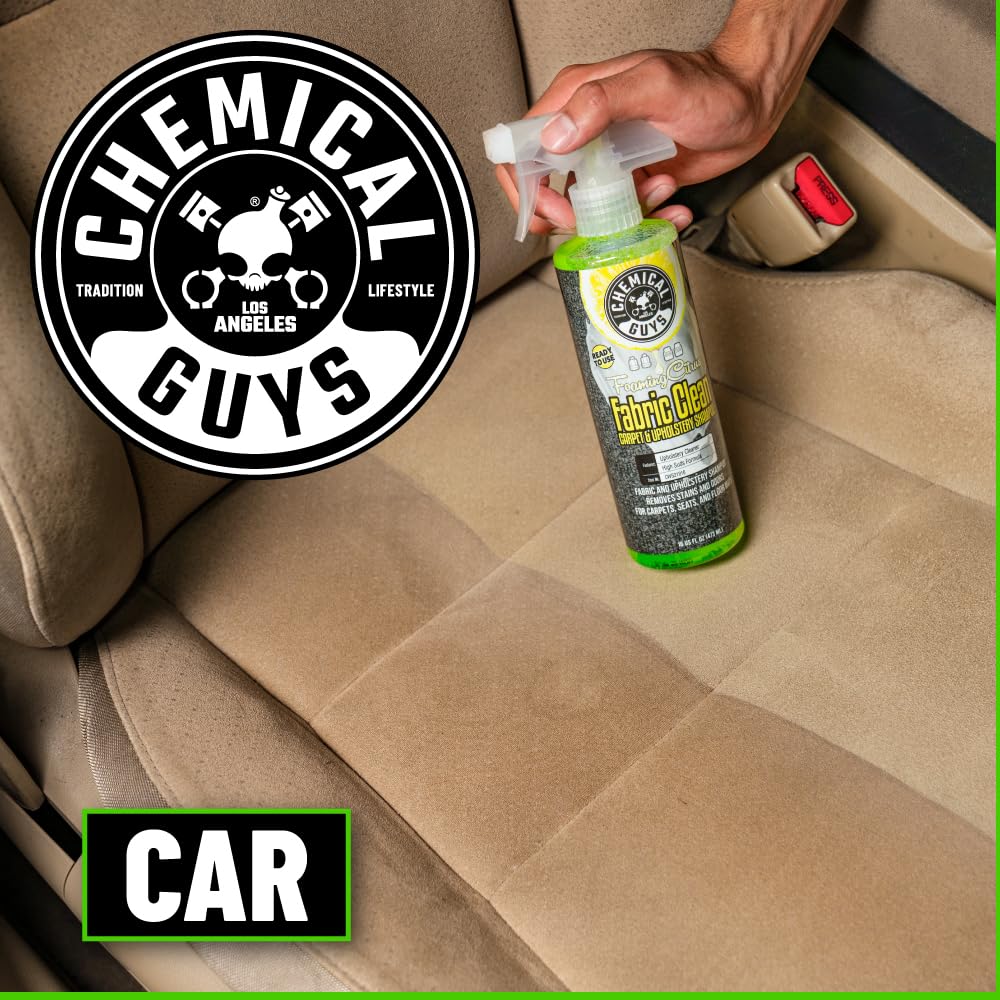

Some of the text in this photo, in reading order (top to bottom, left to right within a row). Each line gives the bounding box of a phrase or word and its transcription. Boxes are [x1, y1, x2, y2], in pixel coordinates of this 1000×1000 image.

[813, 175, 839, 206] PRESS
[611, 271, 669, 312] CHEMICAL
[628, 314, 667, 336] GUYS
[592, 346, 612, 360] READY
[602, 354, 615, 364] USE
[606, 373, 668, 395] Foaming
[609, 376, 712, 433] Fabric Clean
[618, 431, 644, 445] CARPET
[644, 429, 651, 443] &
[651, 416, 695, 442] UPHOLSTERY
[634, 487, 655, 496] FABRIC
[656, 485, 670, 494] AND
[670, 472, 708, 492] UPHOLSTERY
[645, 494, 676, 506] REMOVES
[676, 487, 699, 501] STAINS
